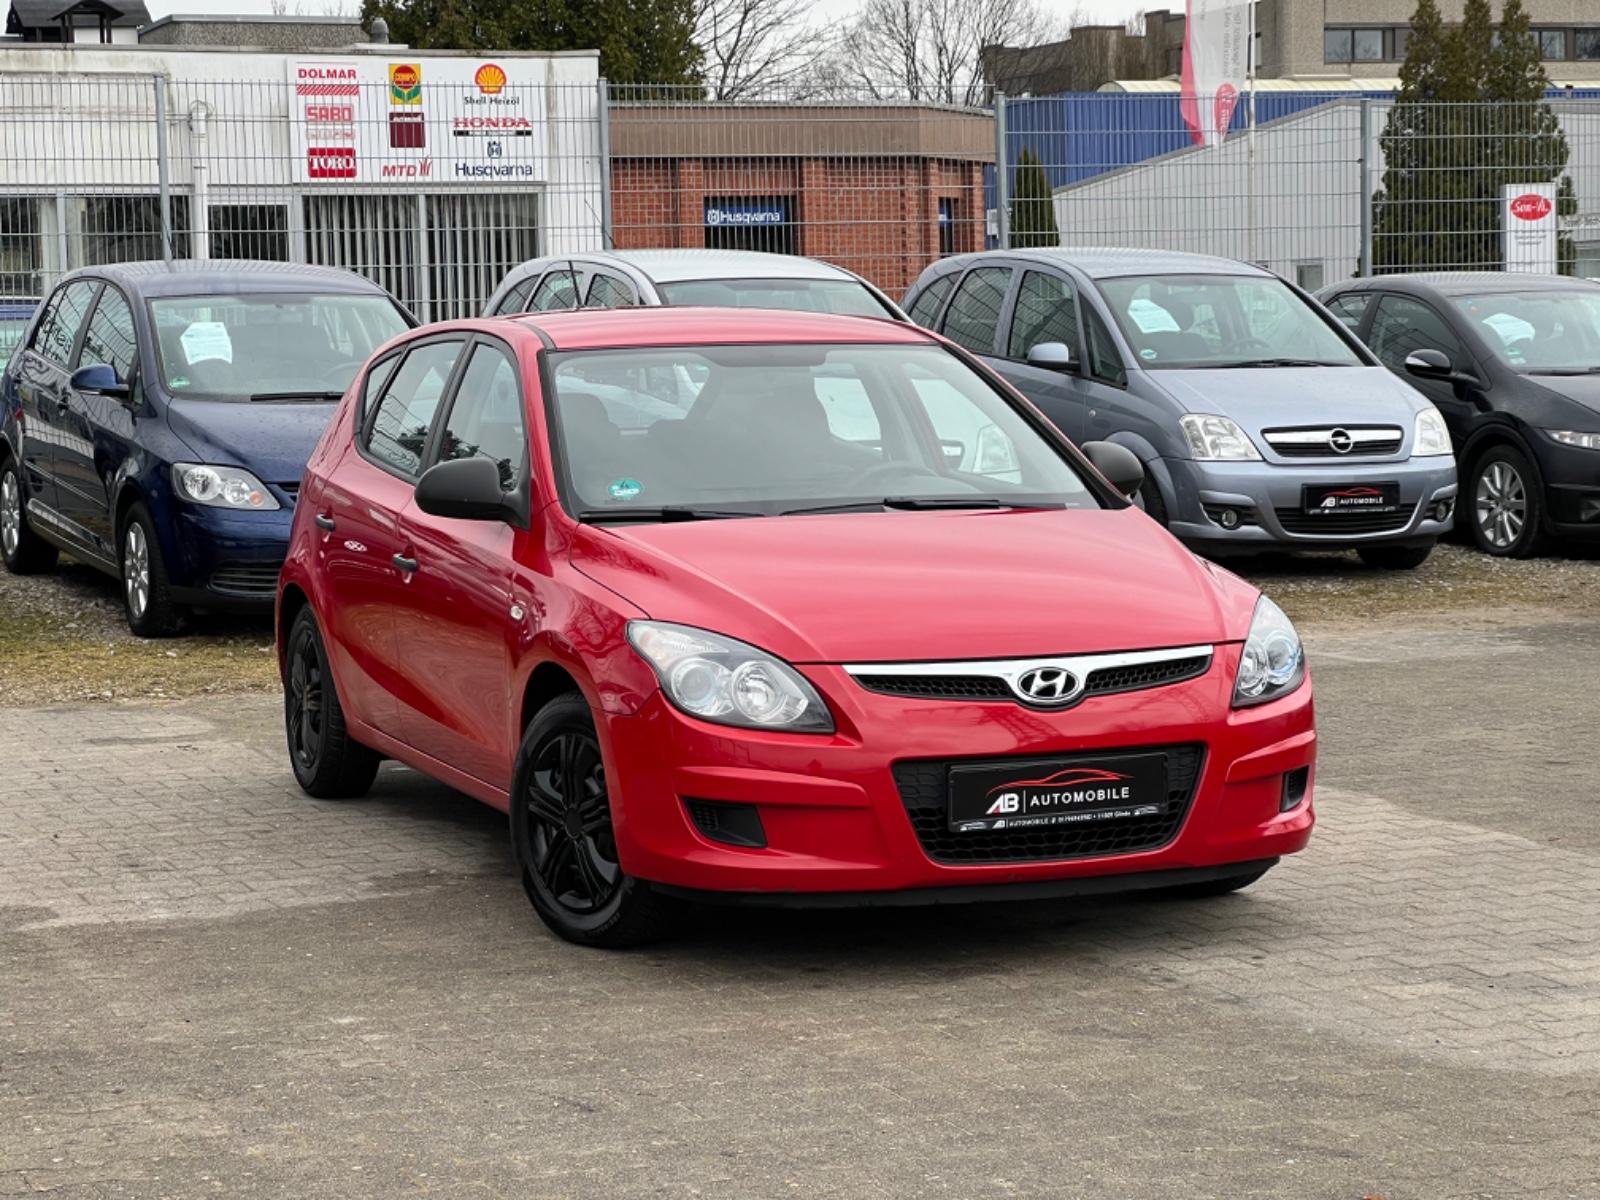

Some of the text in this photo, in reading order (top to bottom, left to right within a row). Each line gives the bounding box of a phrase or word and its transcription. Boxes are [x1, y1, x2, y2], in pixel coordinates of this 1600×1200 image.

[298, 69, 357, 79] DOLMAR
[464, 96, 520, 105] Shell Heizöl
[307, 106, 352, 122] SABO
[453, 117, 533, 128] HONDA
[309, 156, 355, 169] TORO
[382, 165, 417, 177] MTD
[455, 163, 533, 179] Husqvarna
[720, 210, 780, 224] Husqvarna
[1320, 496, 1384, 507] AB AUTOMOBILE
[985, 787, 1131, 815] AB AUTOMOBILE
